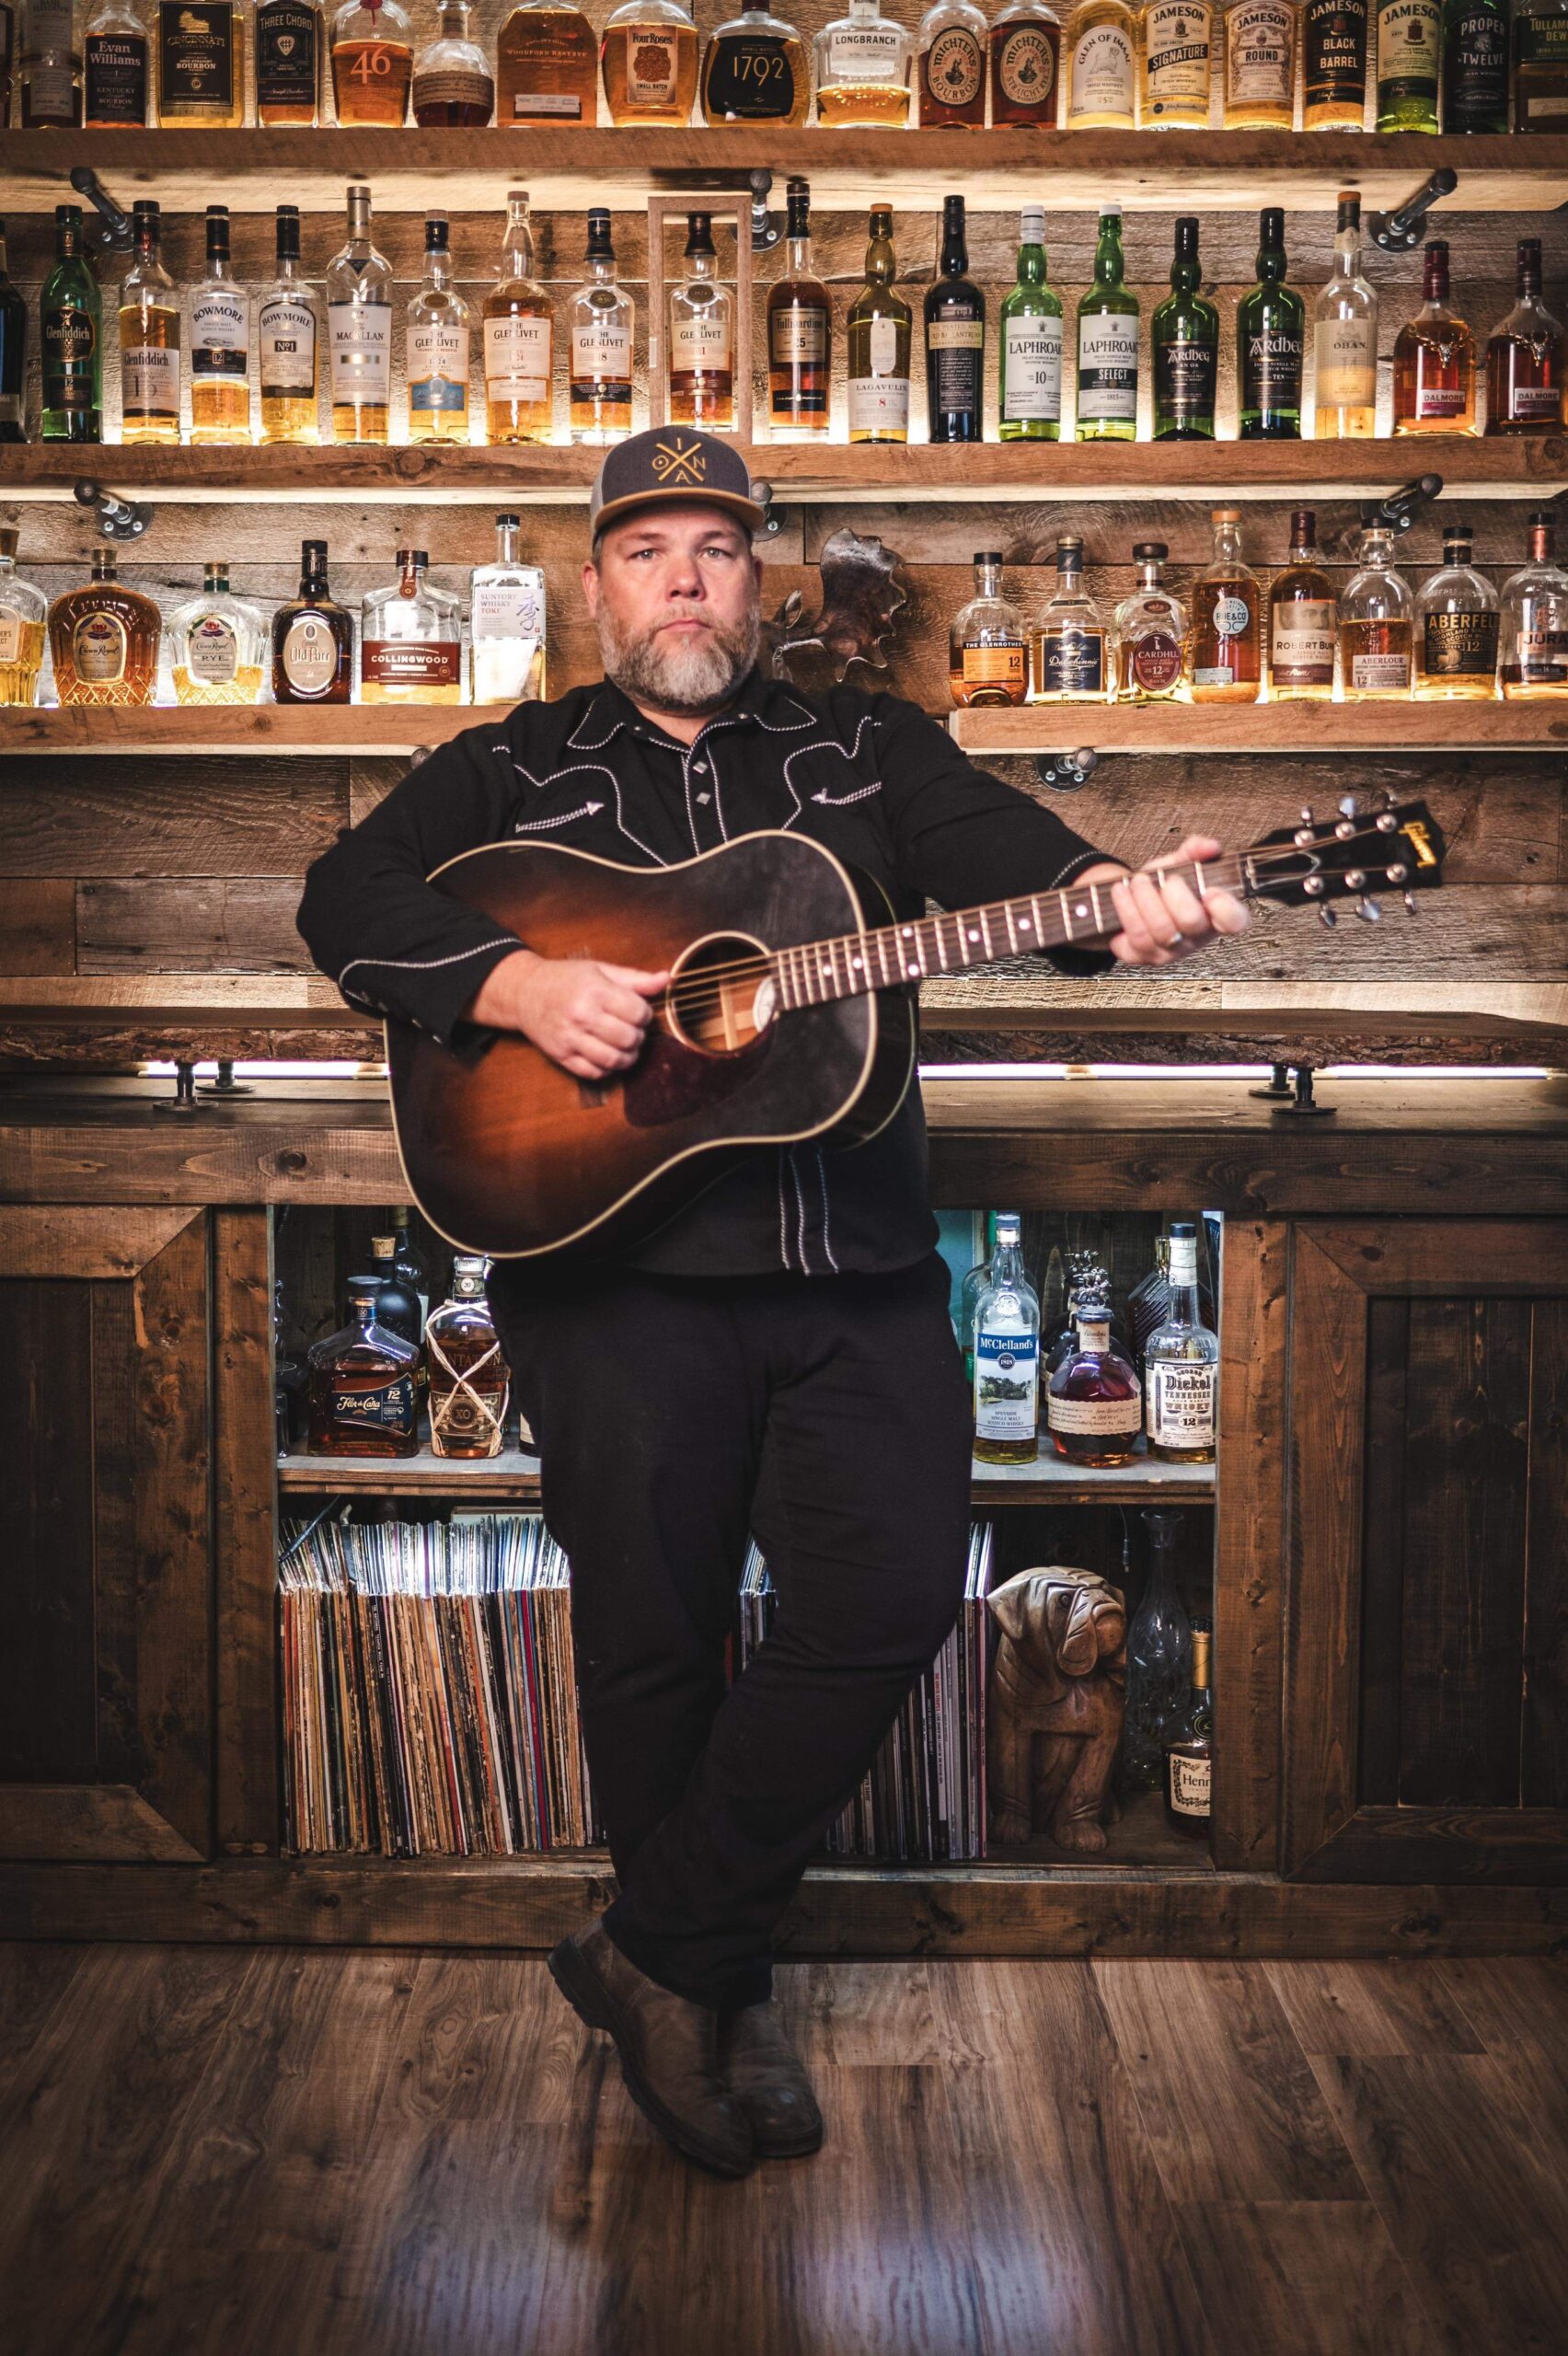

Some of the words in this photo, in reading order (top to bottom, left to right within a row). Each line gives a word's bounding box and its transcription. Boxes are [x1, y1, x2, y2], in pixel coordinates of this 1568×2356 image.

[1153, 6, 1205, 24] JAMESON
[1310, 0, 1366, 20] JAMESON
[259, 15, 283, 29] THREE
[286, 13, 312, 30] CHORD
[1237, 13, 1287, 29] JAMESON
[1461, 17, 1505, 36] PROPER
[1530, 17, 1568, 31] TULLAM
[167, 35, 225, 47] CINCINNATI
[632, 33, 650, 43] Four
[650, 33, 674, 44] Roses
[836, 35, 896, 46] LONGBRANCH
[1323, 39, 1355, 50] BLACK
[98, 41, 131, 53] Evan
[933, 37, 977, 66] MICHTER'S
[1007, 37, 1049, 66] MICHTER'S
[1078, 40, 1097, 64] GLEN
[1098, 34, 1112, 42] OF
[1113, 37, 1131, 64] IMAAL
[90, 53, 141, 66] Williams
[1152, 46, 1205, 70] SIGNATURE
[1246, 50, 1278, 62] ROUND
[1461, 52, 1505, 66] TWELVE
[350, 46, 391, 84] 46
[1320, 57, 1358, 69] BARREL
[733, 57, 784, 87] 1792
[933, 75, 977, 98] BOURBON
[193, 306, 244, 324] BOWMORE
[262, 313, 311, 328] BOWMORE
[46, 326, 90, 341] Glenfiddich
[337, 332, 385, 341] MACLLAN
[1334, 341, 1367, 350] OBAN
[124, 352, 169, 366] Glenfiddich
[213, 353, 223, 362] 12
[1035, 372, 1047, 385] 10
[1099, 368, 1128, 379] SELECT
[878, 398, 885, 407] 8
[1428, 614, 1498, 629] ABERFEL
[1435, 628, 1469, 642] HIGHLAND
[79, 645, 98, 655] Crown
[98, 644, 120, 655] Royal
[1277, 641, 1318, 650] ROBERT
[290, 647, 307, 664] Old
[372, 655, 447, 664] COLLINGWOOD
[1137, 651, 1177, 659] CARDHU
[1009, 657, 1020, 668] 12
[1152, 666, 1163, 675] 12
[1357, 676, 1367, 685] 12
[1165, 1375, 1211, 1391] Dickel
[387, 1390, 401, 1399] 12
[1165, 1391, 1211, 1399] TENNESSEE
[337, 1397, 357, 1410] Flor
[363, 1397, 381, 1410] Caña
[455, 1409, 471, 1419] XO
[1183, 1417, 1196, 1426] 12
